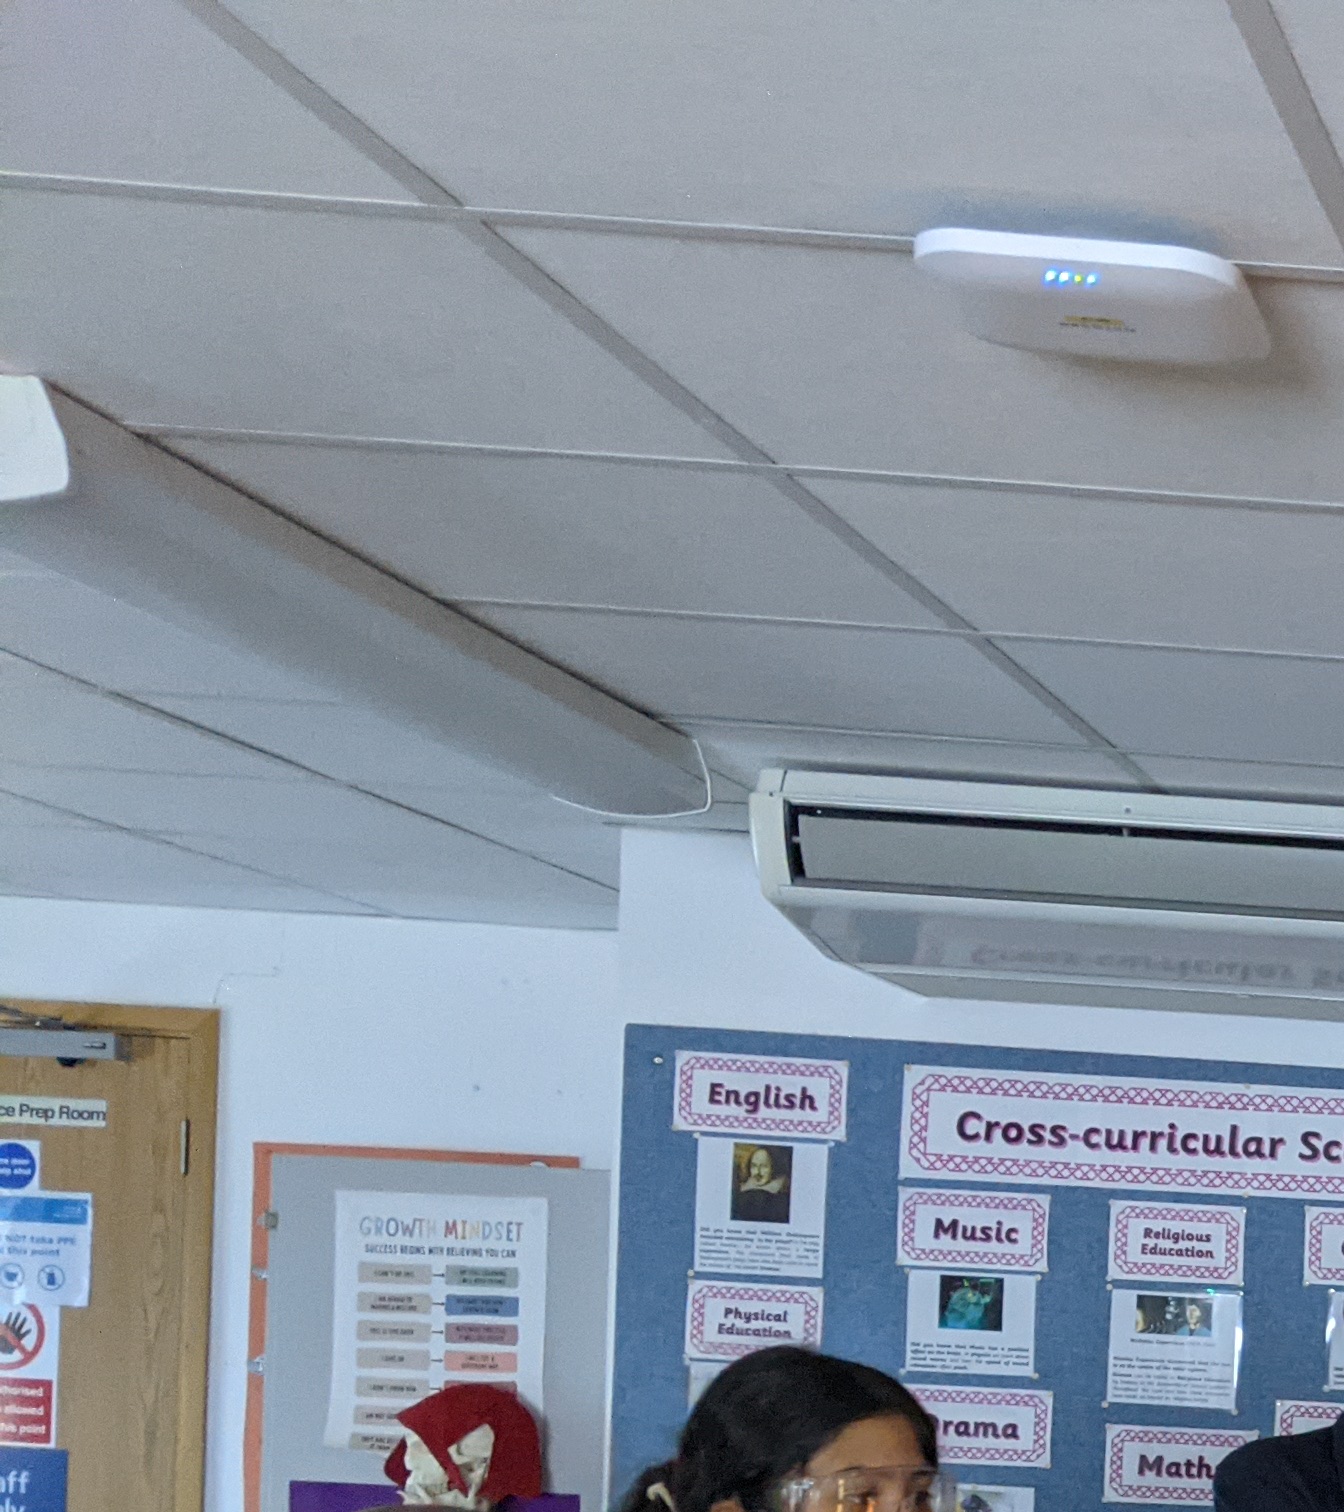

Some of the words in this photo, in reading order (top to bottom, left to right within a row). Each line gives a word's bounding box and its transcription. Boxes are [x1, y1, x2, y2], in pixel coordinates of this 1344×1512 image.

[708, 1082, 818, 1115] English
[19, 1103, 55, 1122] Prep
[59, 1105, 106, 1121] Room
[955, 1111, 1286, 1161] Cross-curricular
[360, 1216, 437, 1238] GROWTH
[444, 1219, 524, 1242] MINDSET
[932, 1217, 1019, 1244] Music
[1142, 1227, 1213, 1245] Religious
[1140, 1244, 1215, 1261] Education
[724, 1306, 788, 1324] Physical
[717, 1323, 792, 1339] Education
[1137, 1453, 1215, 1481] Math
